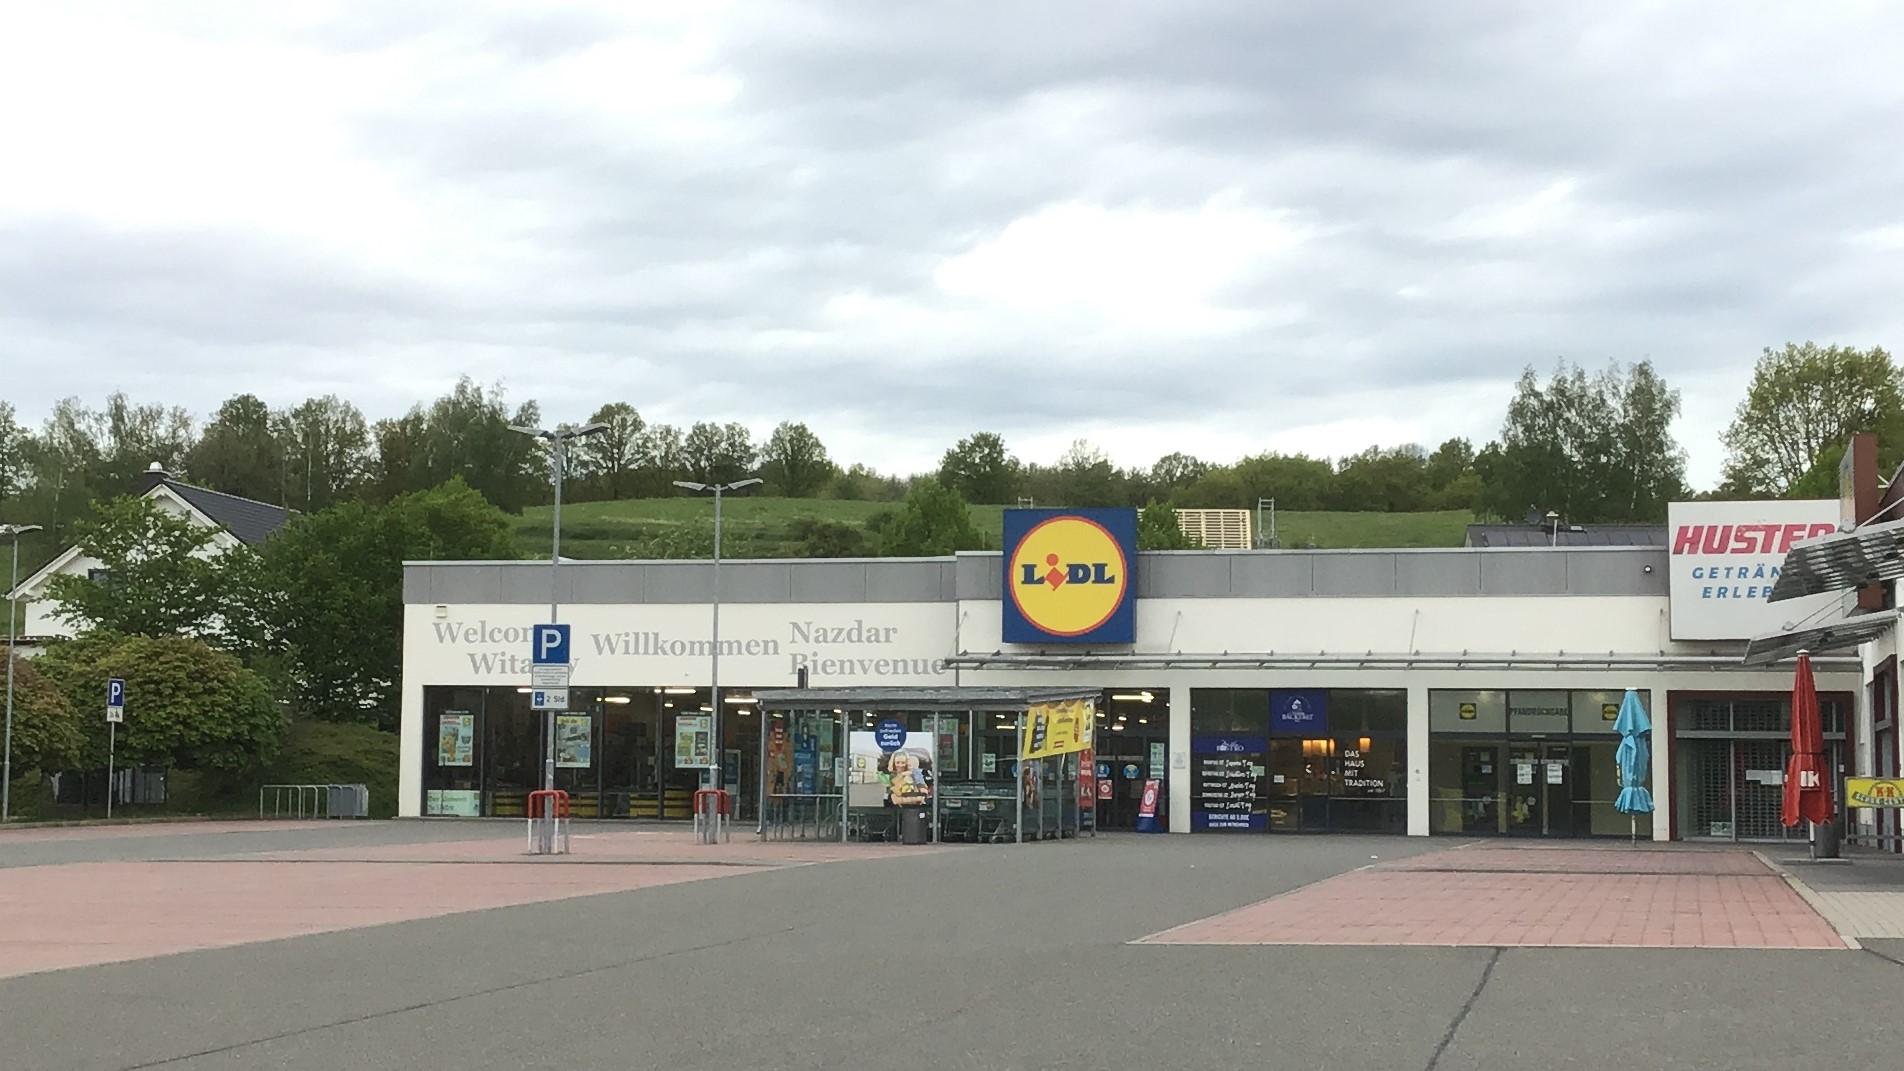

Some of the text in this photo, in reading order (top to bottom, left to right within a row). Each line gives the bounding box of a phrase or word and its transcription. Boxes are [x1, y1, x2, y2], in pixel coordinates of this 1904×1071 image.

[541, 629, 562, 659] P
[590, 632, 779, 656] Willkommen
[788, 620, 897, 644] Nazdar
[467, 651, 580, 676] Witay
[788, 651, 947, 675] Bienvenue
[111, 682, 121, 703] P
[1344, 750, 1359, 758] DAS
[1344, 760, 1365, 768] HAUS
[1344, 779, 1384, 787] TRADITION
